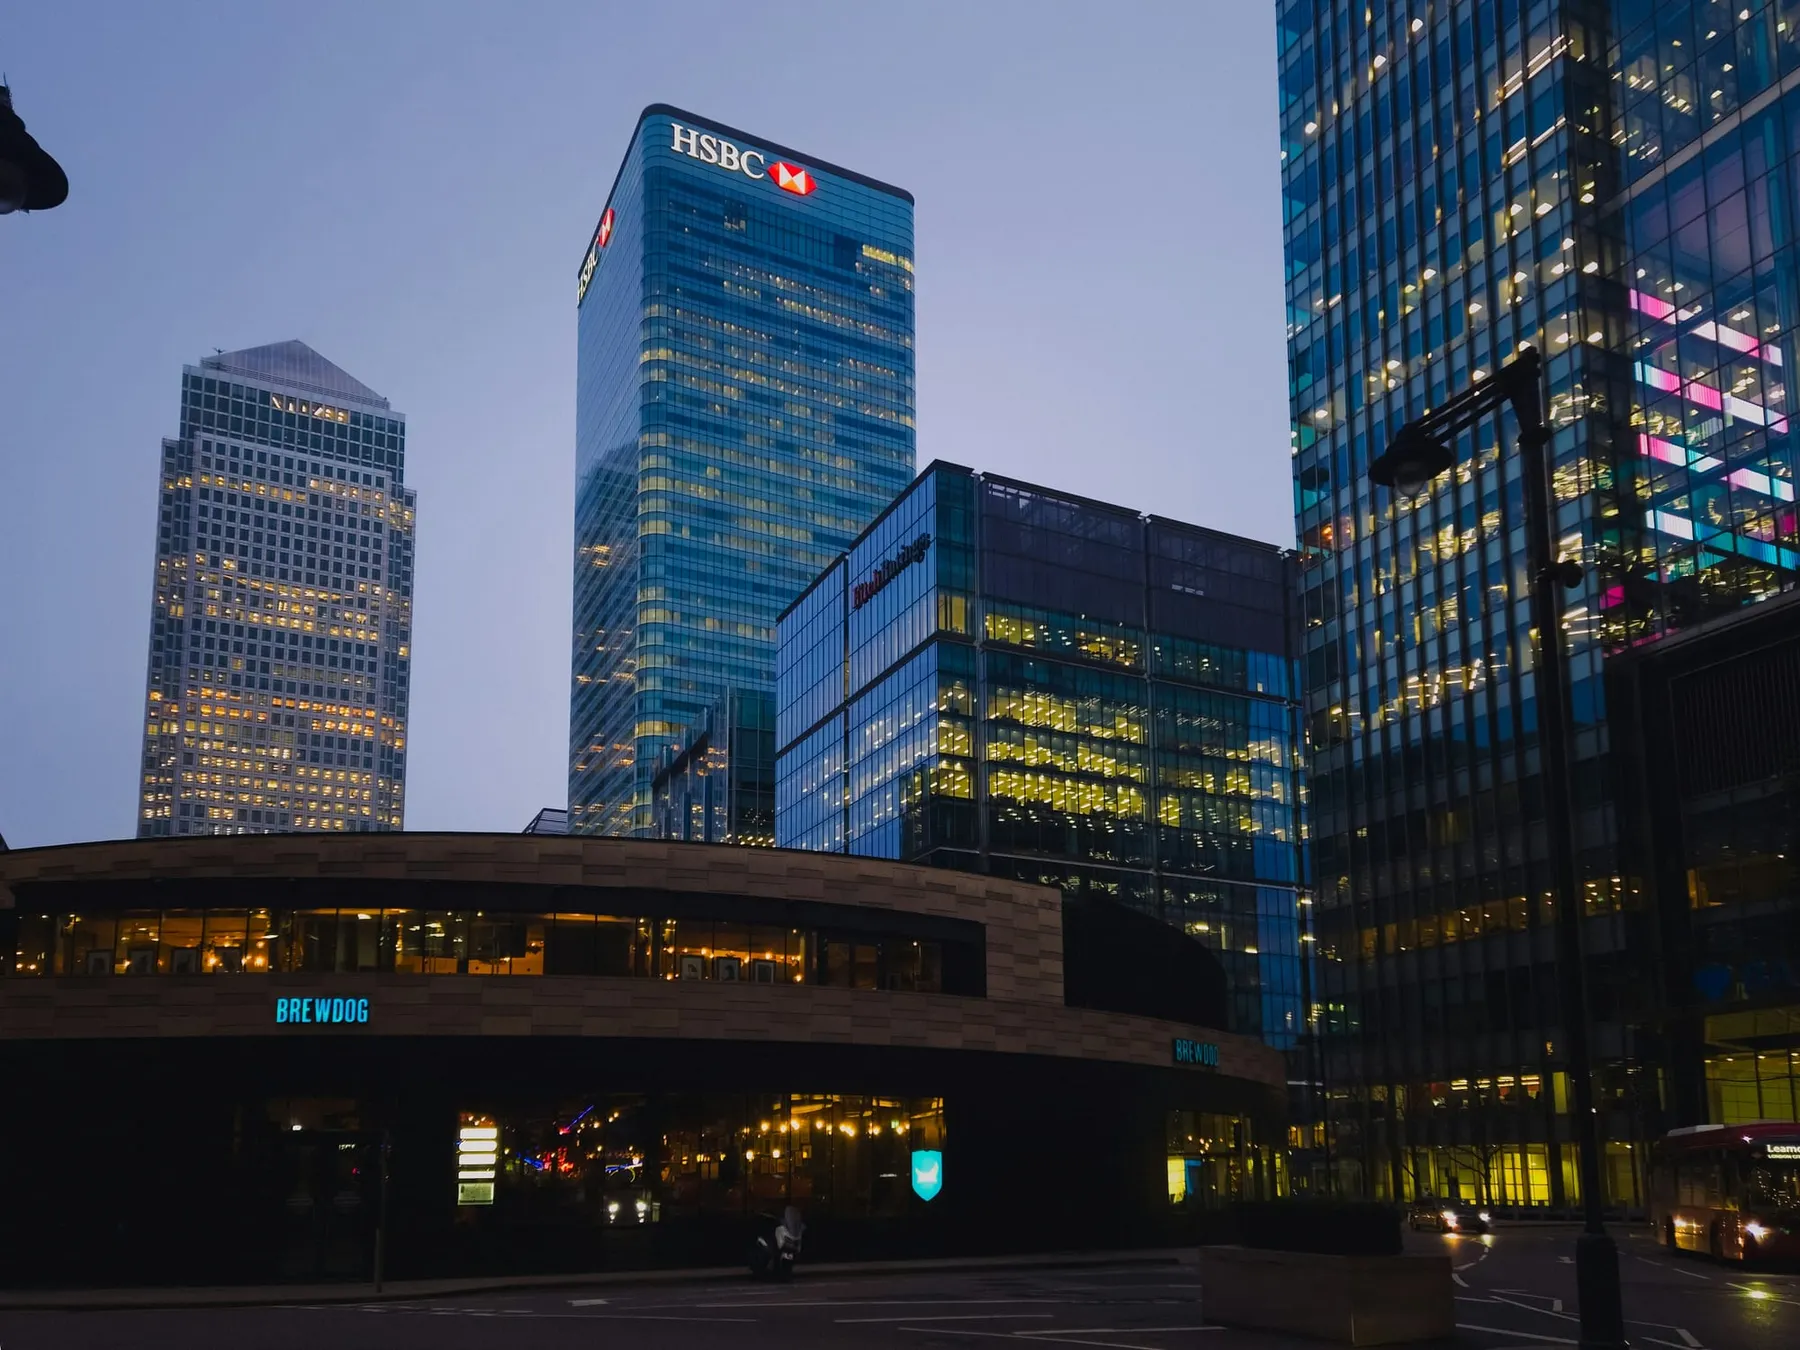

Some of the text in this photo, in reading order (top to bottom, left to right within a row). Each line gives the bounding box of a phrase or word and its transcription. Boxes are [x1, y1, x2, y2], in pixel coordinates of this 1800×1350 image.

[671, 123, 764, 179] HSBC
[577, 236, 599, 304] HSBC
[276, 998, 369, 1023] BREWDOG
